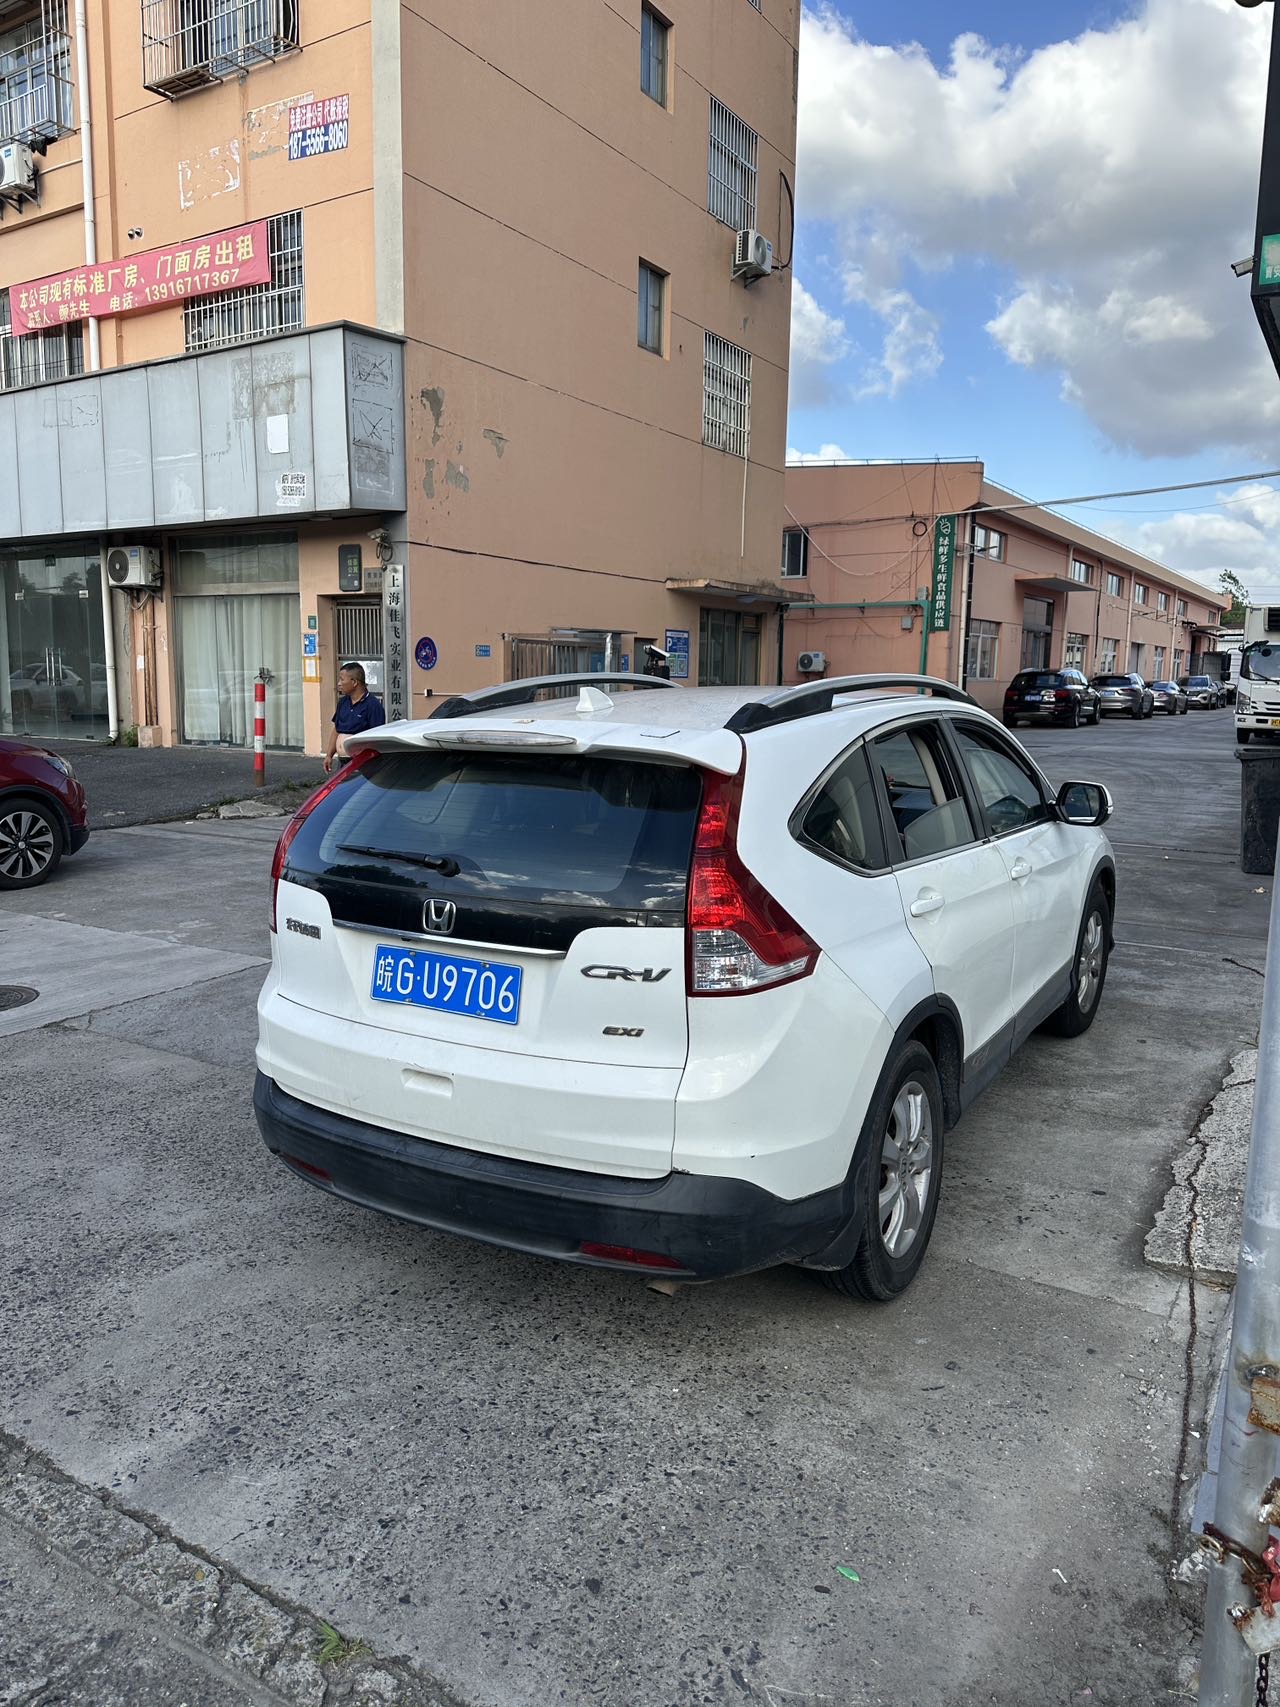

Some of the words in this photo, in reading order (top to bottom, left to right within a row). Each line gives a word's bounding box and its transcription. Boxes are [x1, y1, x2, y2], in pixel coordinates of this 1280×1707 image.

[289, 120, 348, 159] 187-5566-8060
[19, 233, 255, 312] 本公司现有标准厂房、门面房出租
[580, 964, 672, 983] CR-V
